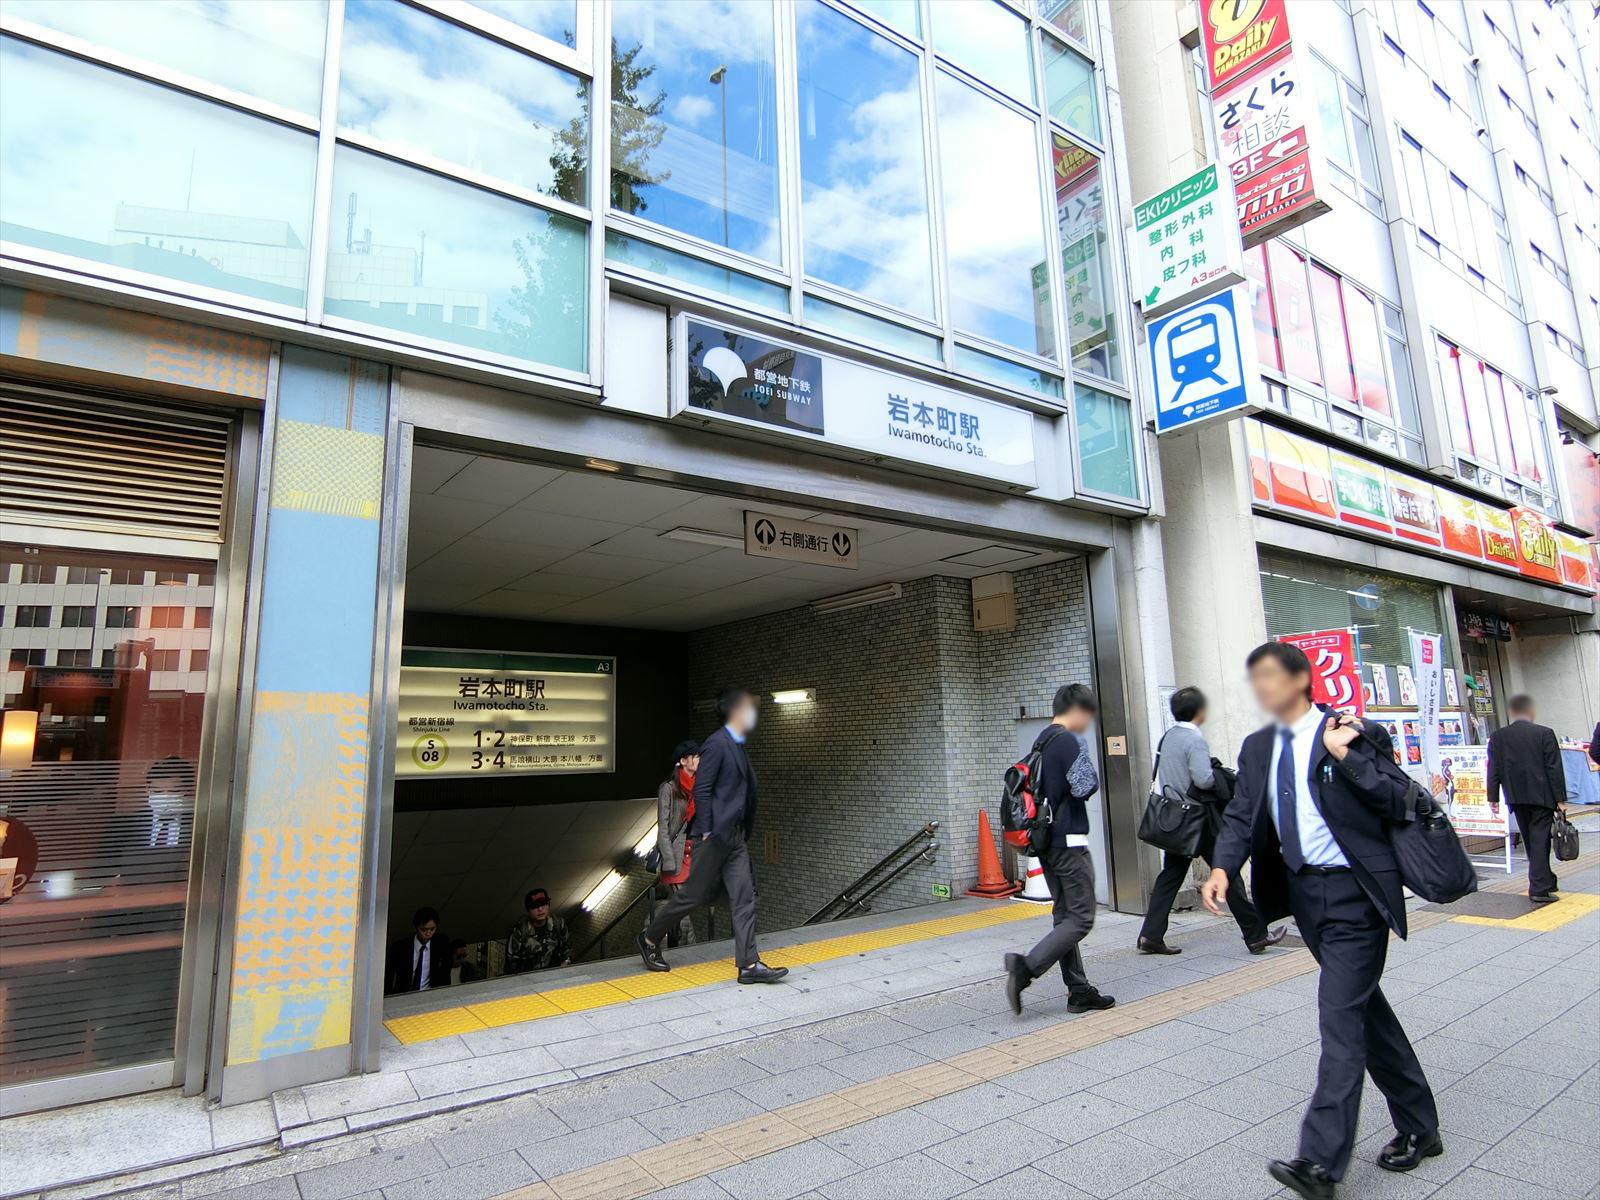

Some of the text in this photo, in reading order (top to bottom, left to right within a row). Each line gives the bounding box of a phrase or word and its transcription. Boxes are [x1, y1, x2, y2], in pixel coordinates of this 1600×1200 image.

[1214, 16, 1278, 68] Daily
[1220, 71, 1294, 129] さくら
[1233, 107, 1291, 156] 相談
[1232, 150, 1264, 180] 3F
[1137, 172, 1215, 226] EKIクリニック
[1149, 201, 1213, 246] 整形外科
[1244, 198, 1297, 227] AKIHABARA
[1163, 250, 1207, 282] 皮フ科
[754, 368, 811, 393] 都営地下鉄
[754, 384, 811, 405] TOEI SUBWAY
[888, 393, 980, 440] 岩本町駅
[888, 423, 987, 458] Iwamotocho Sta.
[780, 531, 828, 552] 右側通行
[597, 663, 610, 671] A3
[458, 676, 545, 699] 岩本町駅
[454, 700, 549, 711] Iwamotocho Sta.
[408, 716, 455, 726] 都営新宿線
[428, 740, 435, 750] S
[510, 734, 533, 743] 神保町
[536, 734, 551, 743] 新宿
[582, 734, 597, 743] 方面
[421, 751, 439, 762] 08
[589, 754, 603, 762] 方面
[1456, 777, 1485, 789] 猫背
[1456, 794, 1485, 806] 矯正
